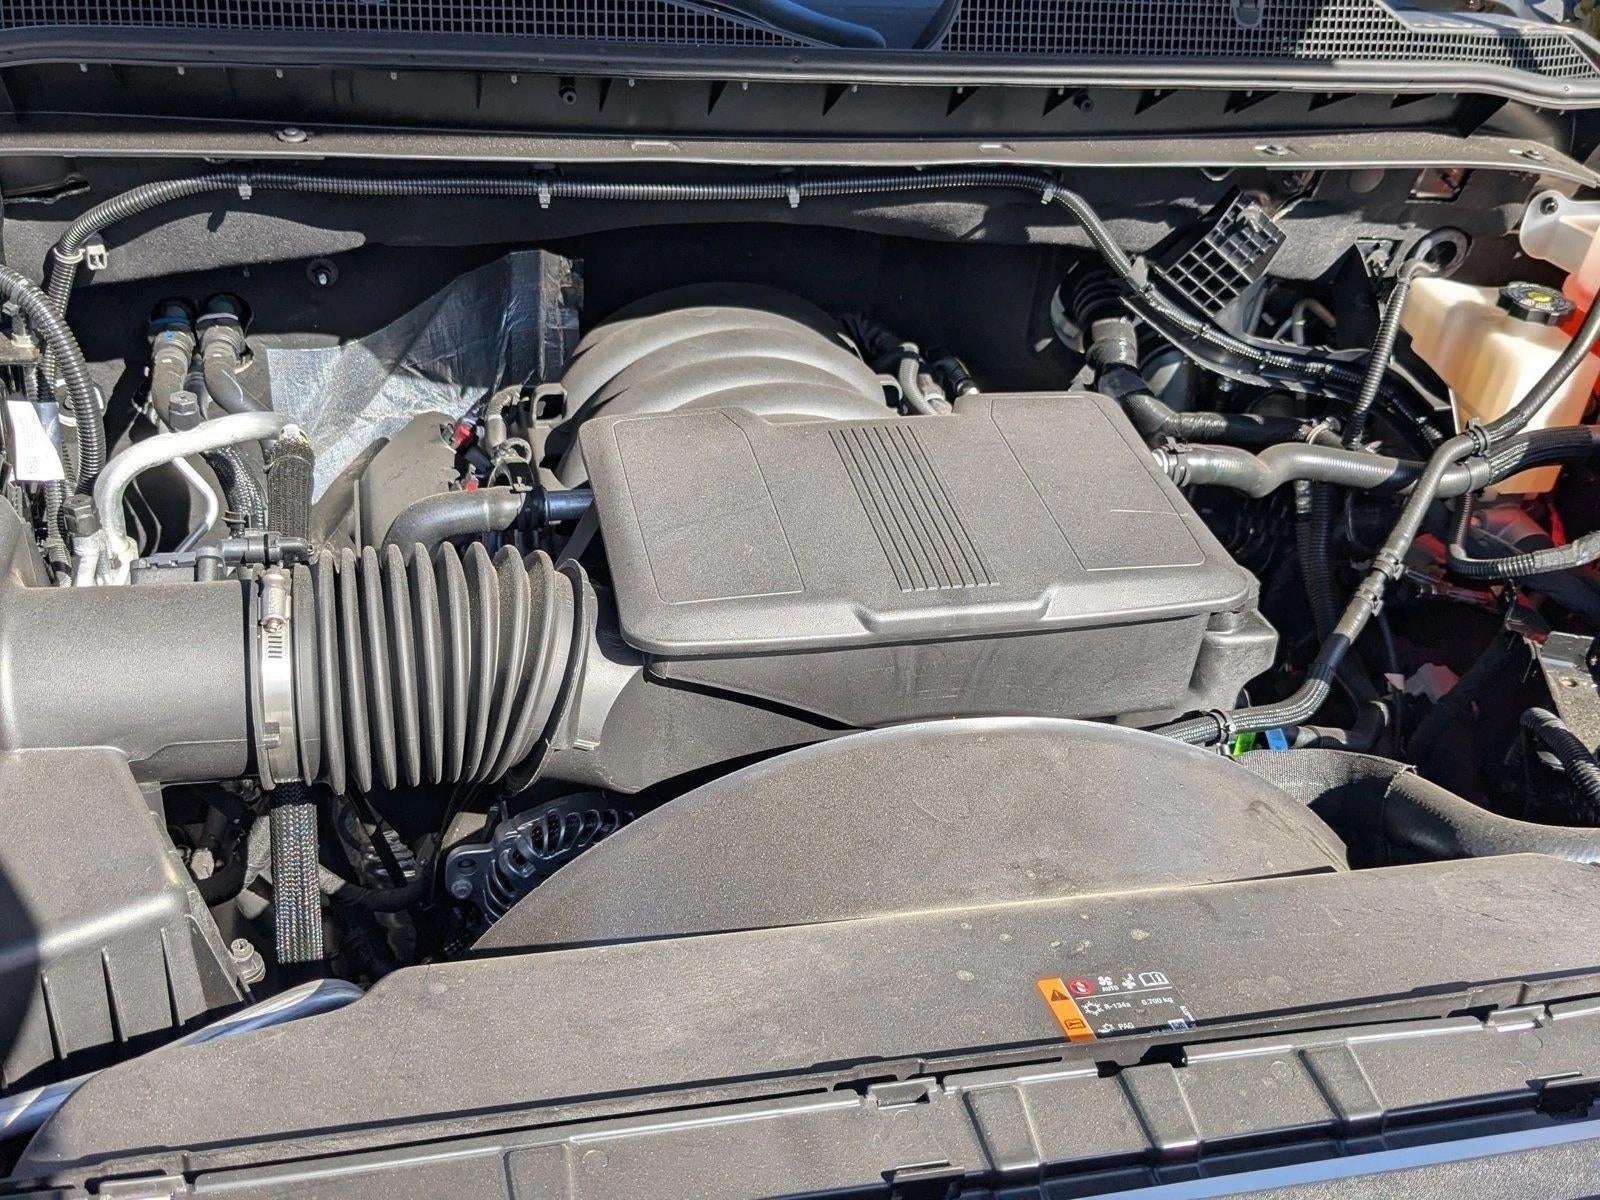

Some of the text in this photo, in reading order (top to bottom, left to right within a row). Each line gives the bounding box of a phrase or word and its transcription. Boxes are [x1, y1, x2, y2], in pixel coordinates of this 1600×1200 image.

[1103, 996, 1174, 1010] R-134a 0.700 kg
[1117, 1021, 1135, 1030] PAG
